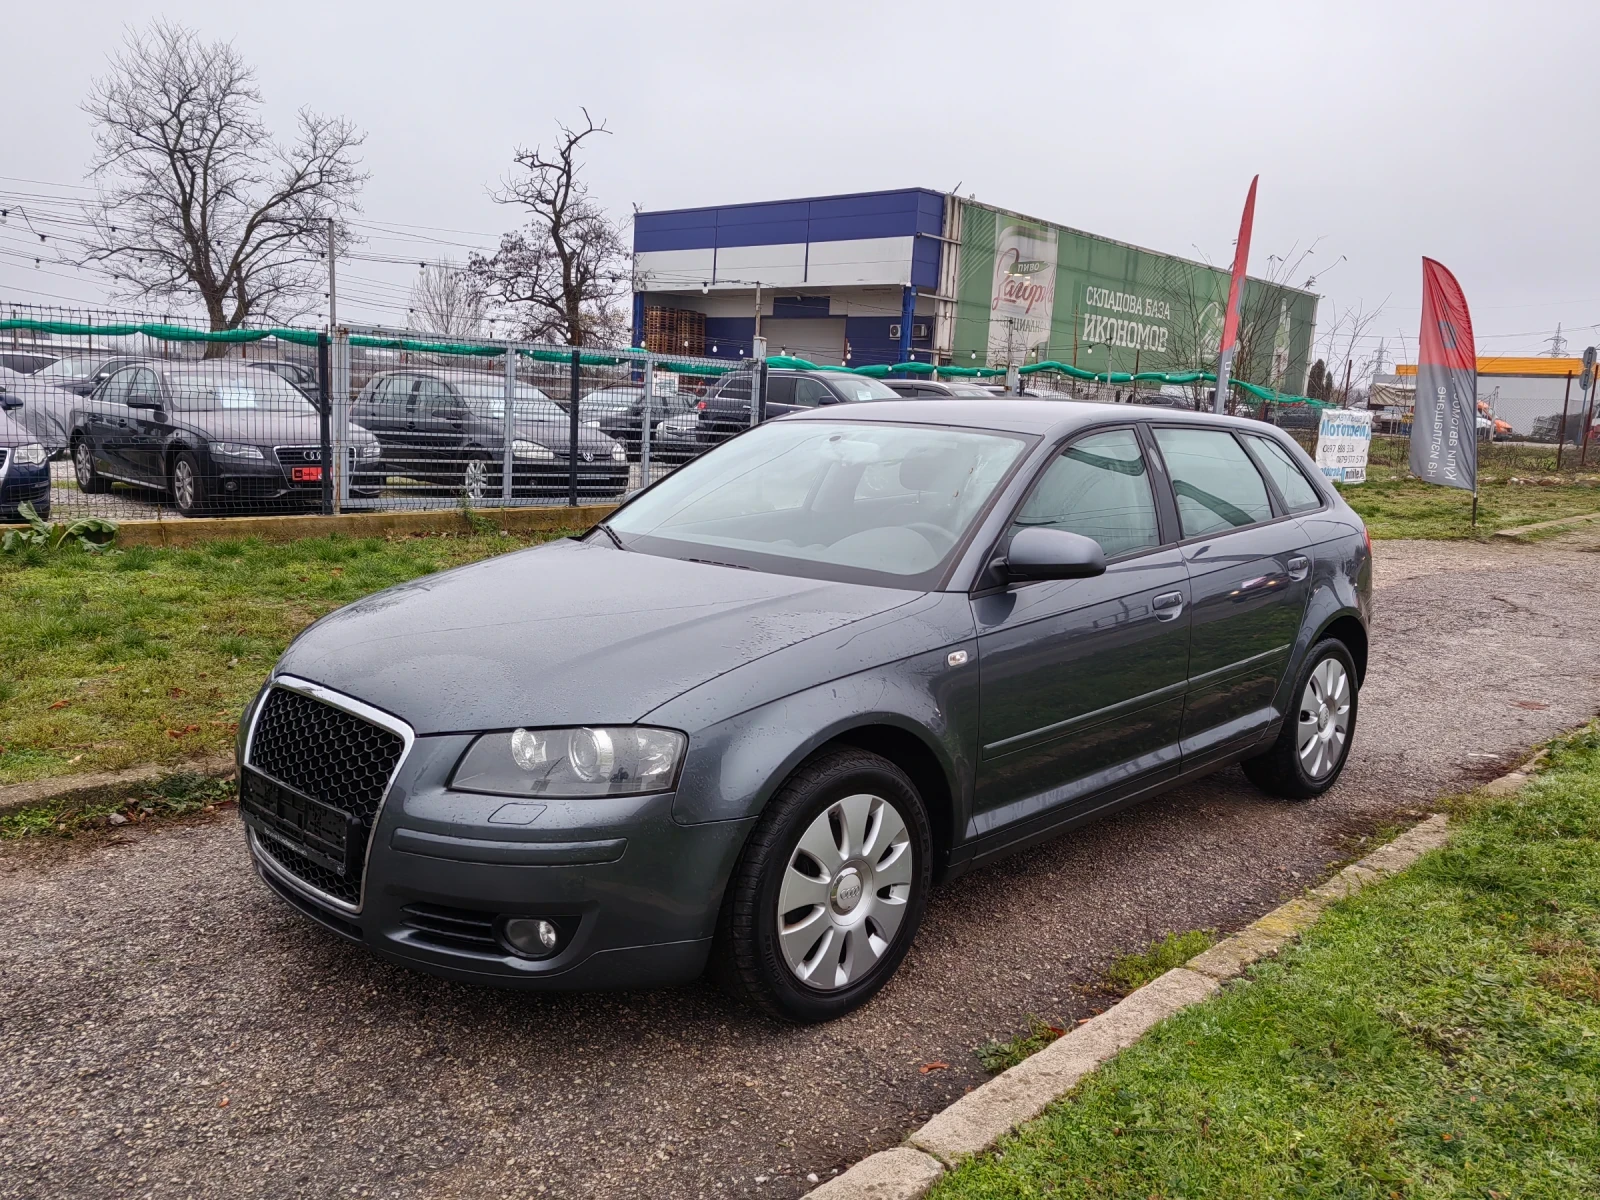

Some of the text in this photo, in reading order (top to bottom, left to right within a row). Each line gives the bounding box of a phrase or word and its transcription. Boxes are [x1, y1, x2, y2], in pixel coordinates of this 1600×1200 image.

[1086, 286, 1170, 320] СКЛАДОВА БАЗА
[1082, 313, 1168, 352] ИКОНОМОВ
